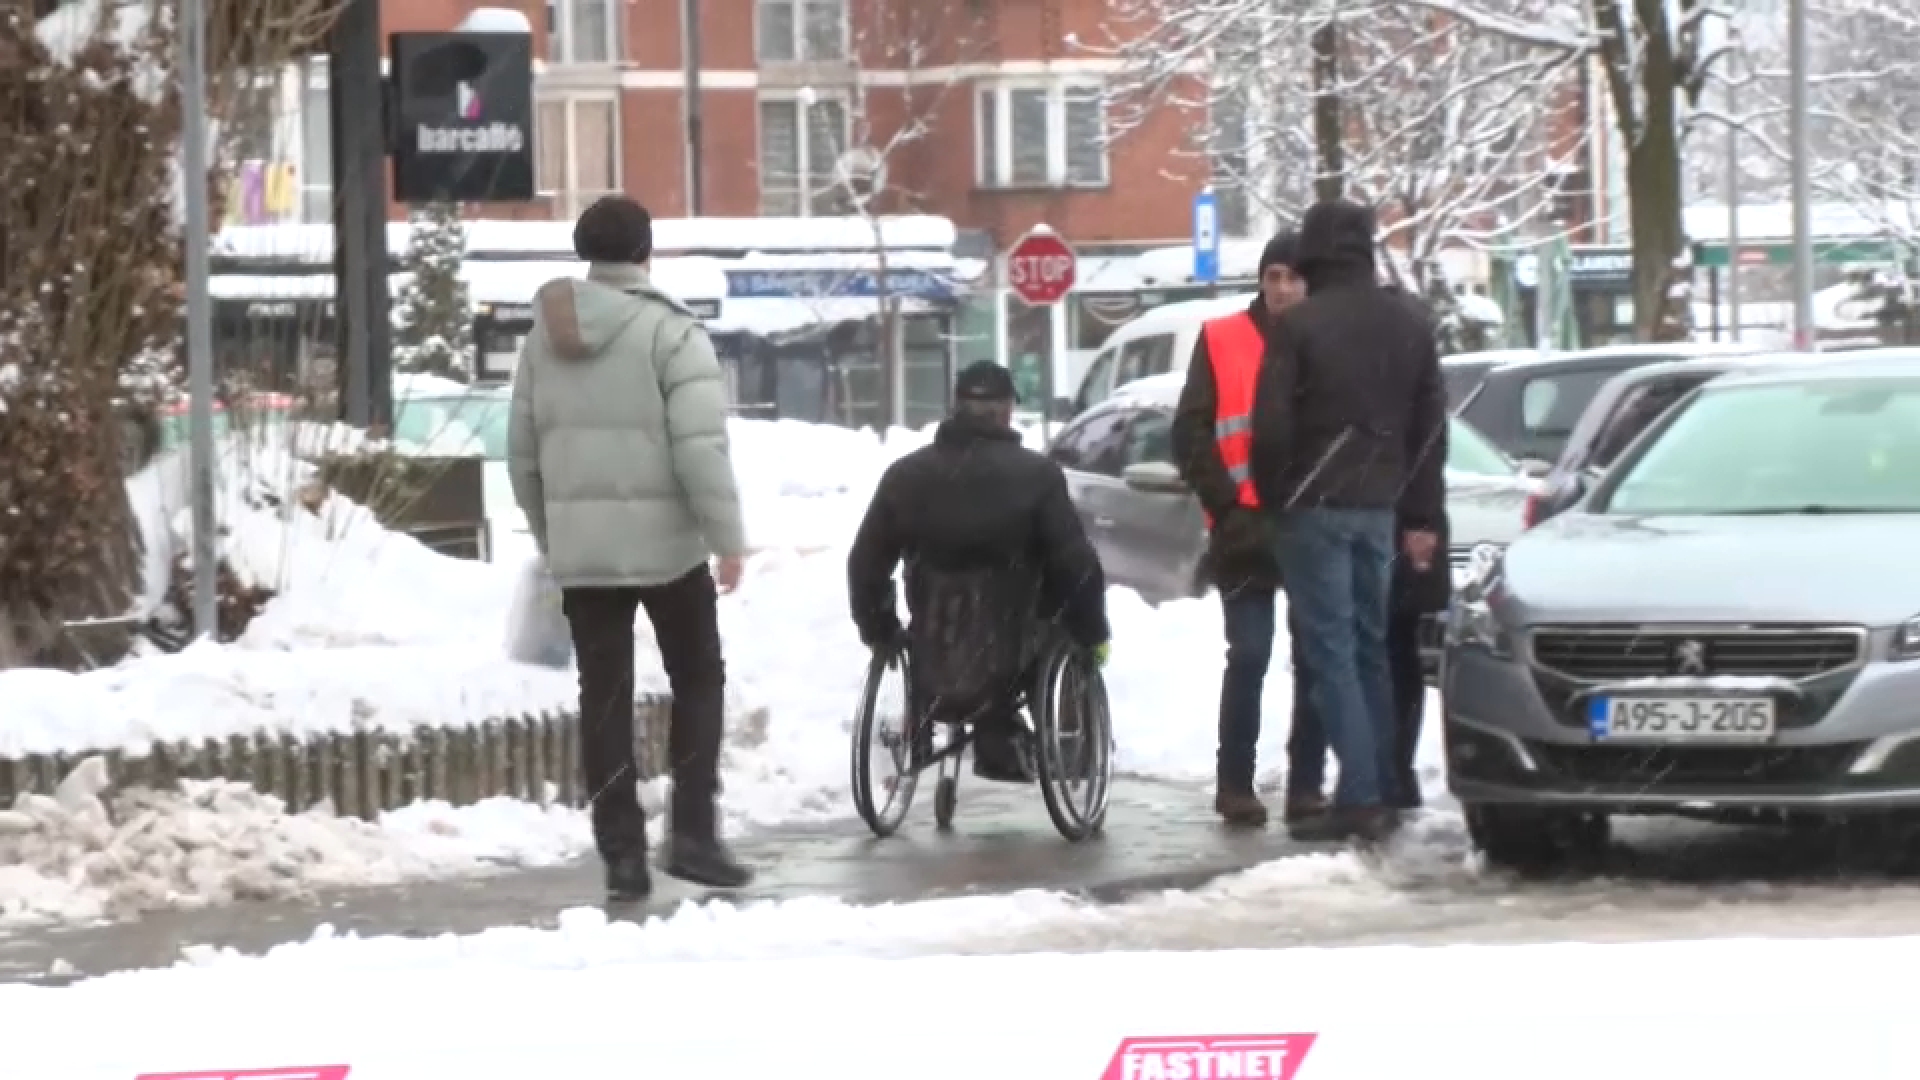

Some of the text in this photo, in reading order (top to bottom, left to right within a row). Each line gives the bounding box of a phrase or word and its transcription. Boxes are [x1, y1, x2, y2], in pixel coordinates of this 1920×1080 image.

[1010, 255, 1071, 282] STOP
[1610, 701, 1770, 732] A95-J-205
[1122, 1049, 1289, 1080] FASTNET
